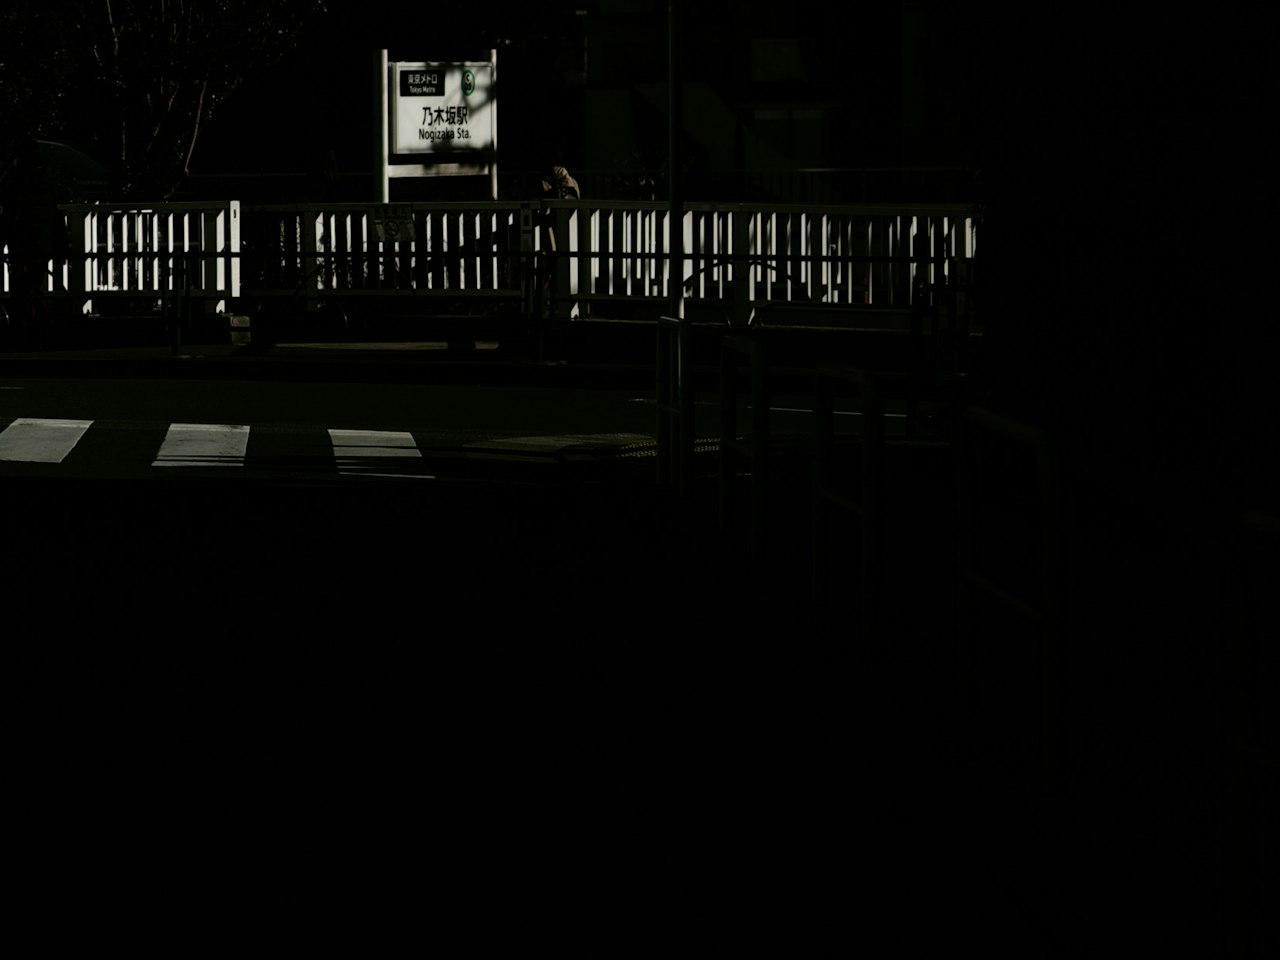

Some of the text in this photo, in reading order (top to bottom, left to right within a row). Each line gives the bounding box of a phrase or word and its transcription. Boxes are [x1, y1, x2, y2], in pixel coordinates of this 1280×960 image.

[407, 73, 438, 85] 東京メトロ
[409, 86, 436, 95] Tokyo Metro
[422, 105, 468, 127] 乃木坂駅
[418, 127, 472, 143] Nogizaka Sta.
